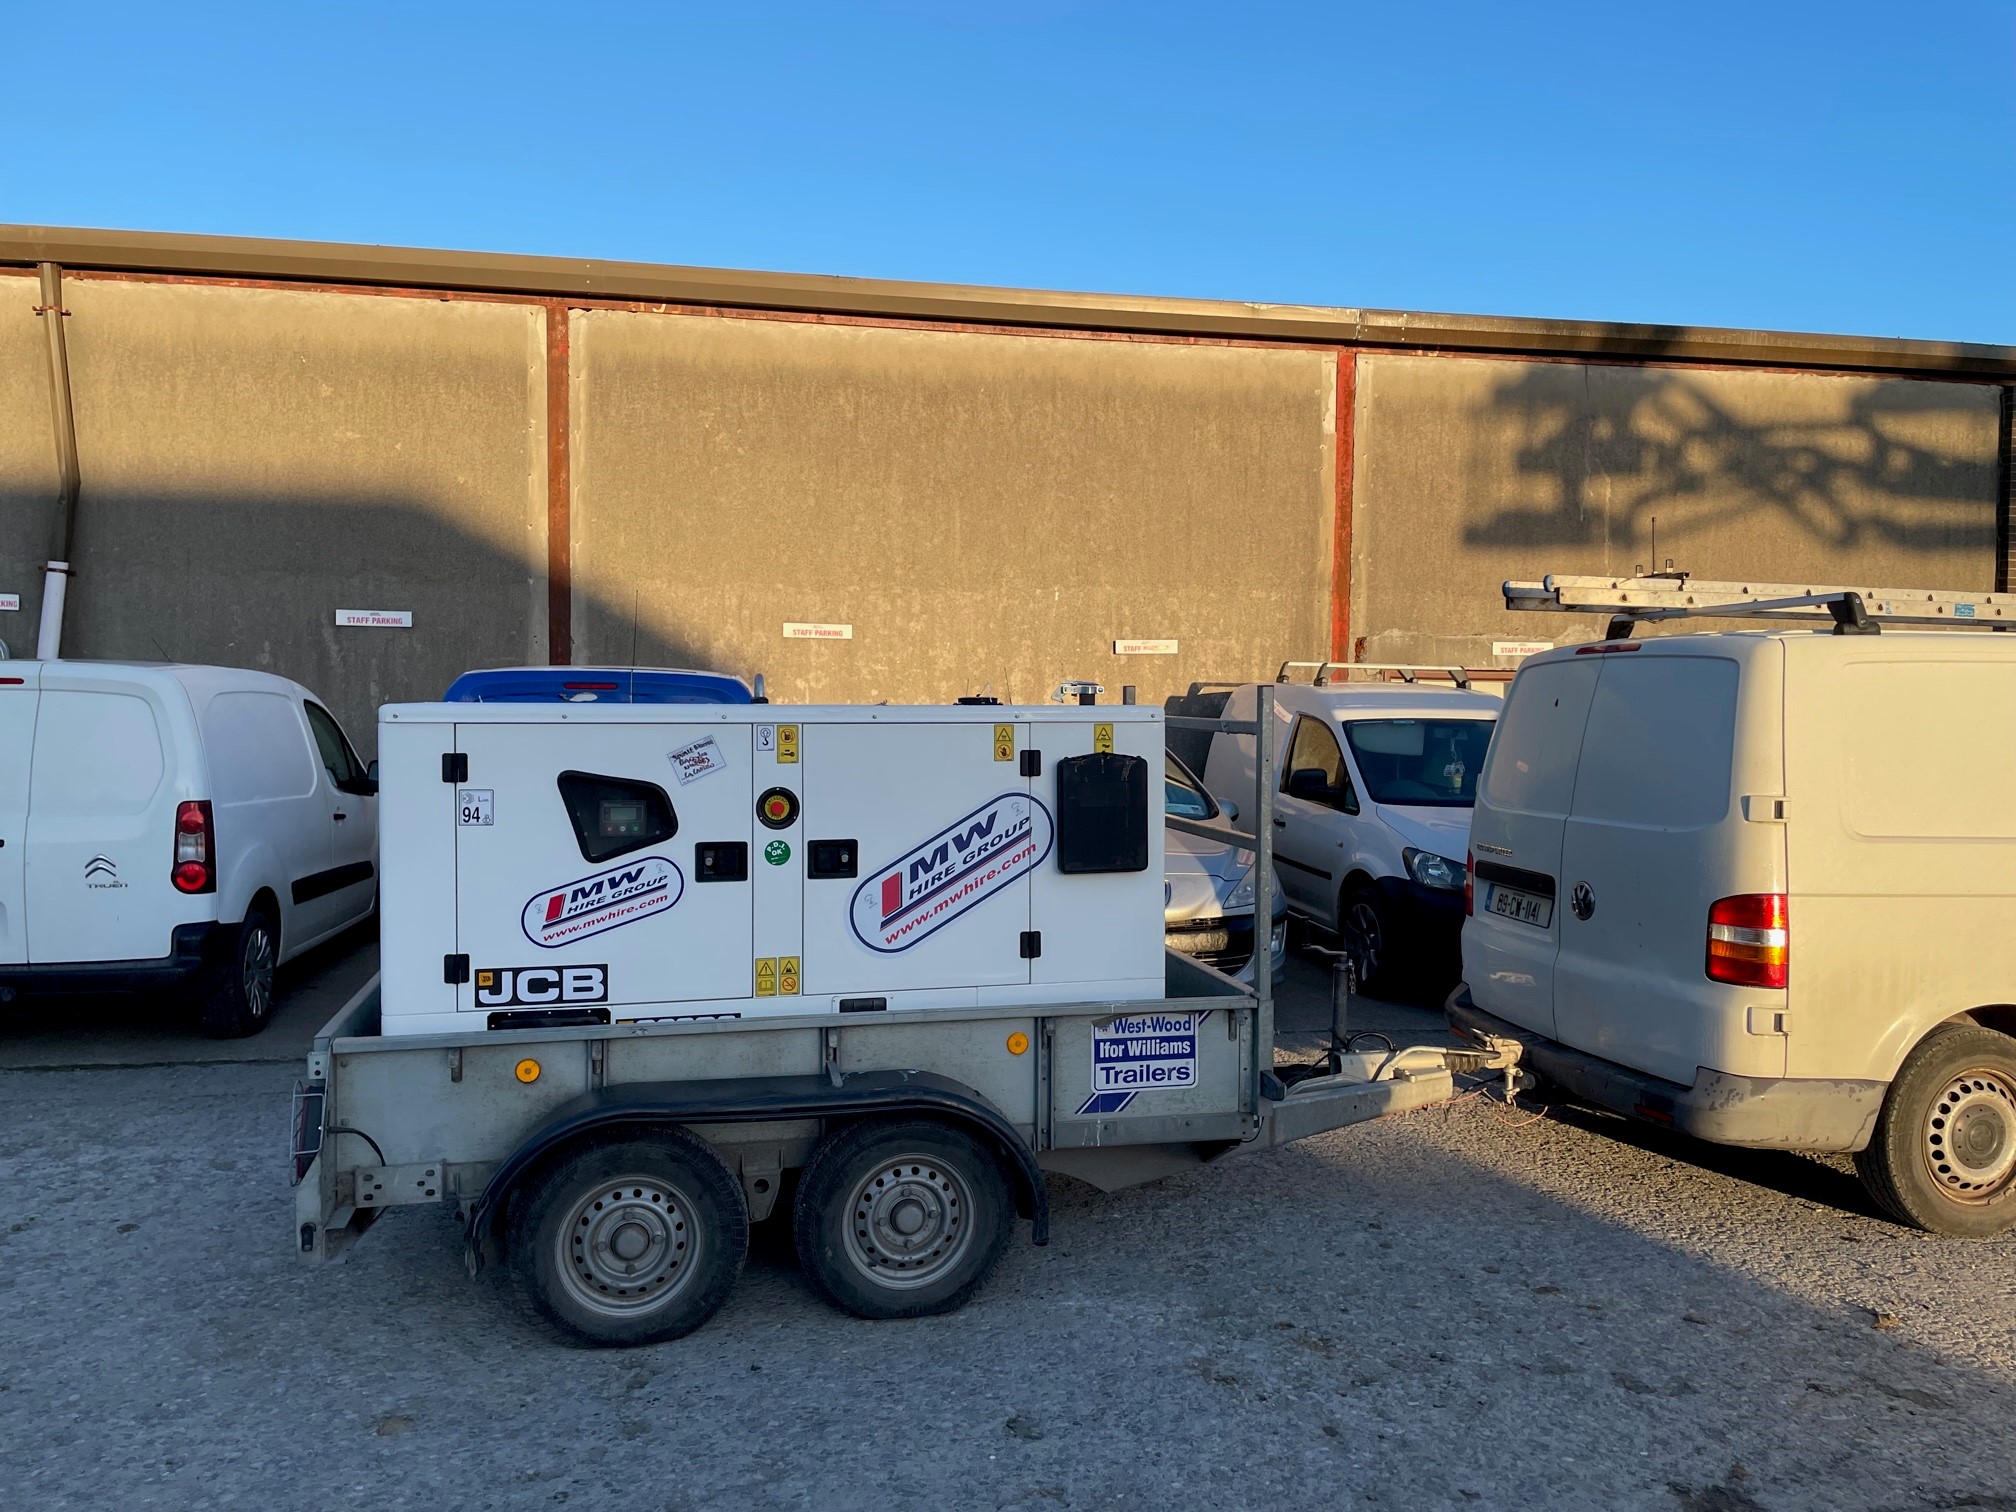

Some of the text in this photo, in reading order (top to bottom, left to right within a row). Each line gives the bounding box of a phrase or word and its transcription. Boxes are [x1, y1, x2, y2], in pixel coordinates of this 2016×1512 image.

[346, 616, 403, 625] STAFF PARKING
[814, 629, 844, 637] PARKING
[462, 806, 481, 823] 94
[771, 849, 783, 857] OK
[908, 816, 1031, 900] HIRE GROUP
[910, 810, 999, 884] MW
[567, 875, 668, 914] HIRE GROUP
[570, 866, 646, 903] MW
[885, 843, 1037, 945] www.mwhire.com
[543, 894, 668, 942] www.mwhire.com
[478, 967, 605, 1005] JCB
[1113, 1014, 1191, 1034] West-Wood
[1100, 1039, 1191, 1058] Ifor Williams
[1100, 1064, 1190, 1085] Trailers
